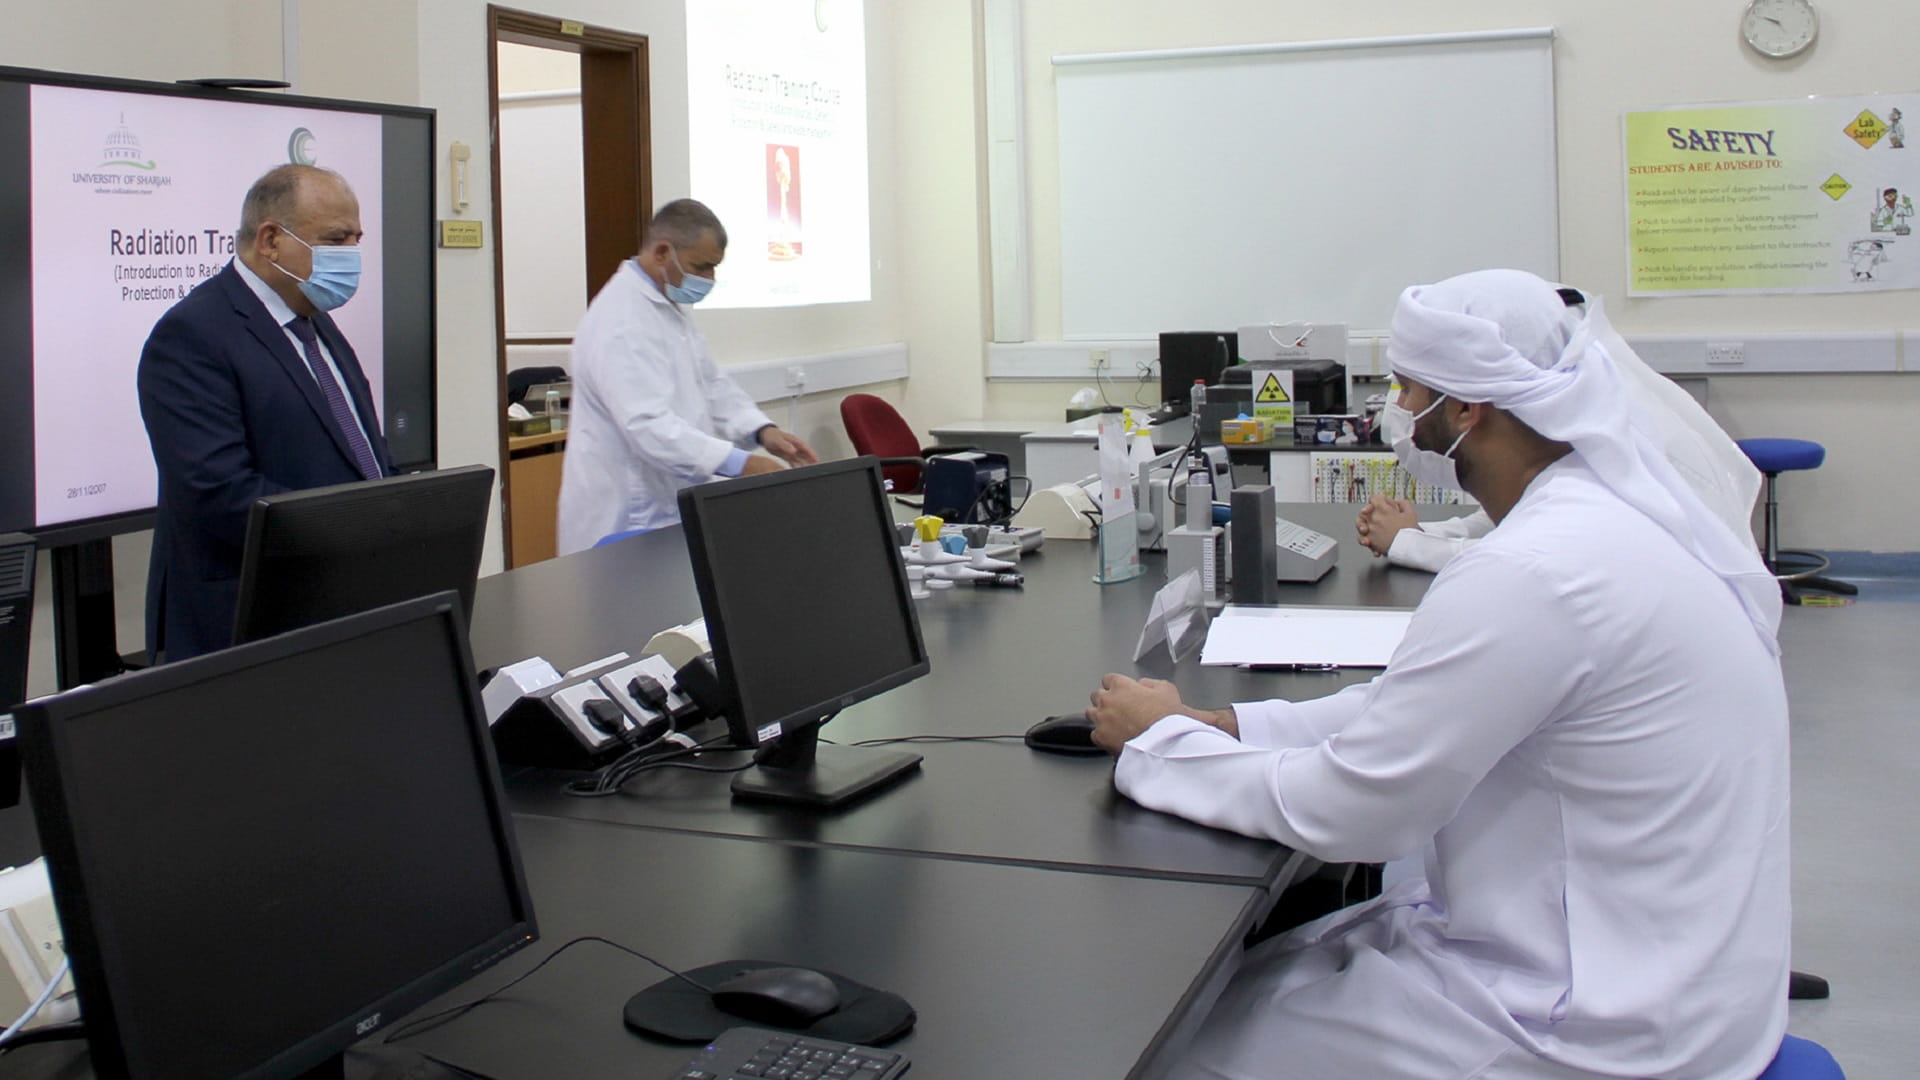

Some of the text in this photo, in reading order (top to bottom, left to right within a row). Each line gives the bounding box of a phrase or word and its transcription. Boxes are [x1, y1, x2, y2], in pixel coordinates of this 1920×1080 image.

[1858, 119, 1874, 128] Lab
[1667, 127, 1777, 156] SAFETY
[1854, 129, 1881, 139] Safety
[1629, 159, 1784, 175] STUDENTS ARE ADVISED TO:
[72, 173, 172, 187] UNIVERSITY OF SHARJAH
[111, 228, 197, 256] Radiation
[114, 264, 182, 283] (Introduction
[186, 264, 196, 279] to
[122, 285, 175, 301] Protection
[356, 1012, 381, 1035] acer
